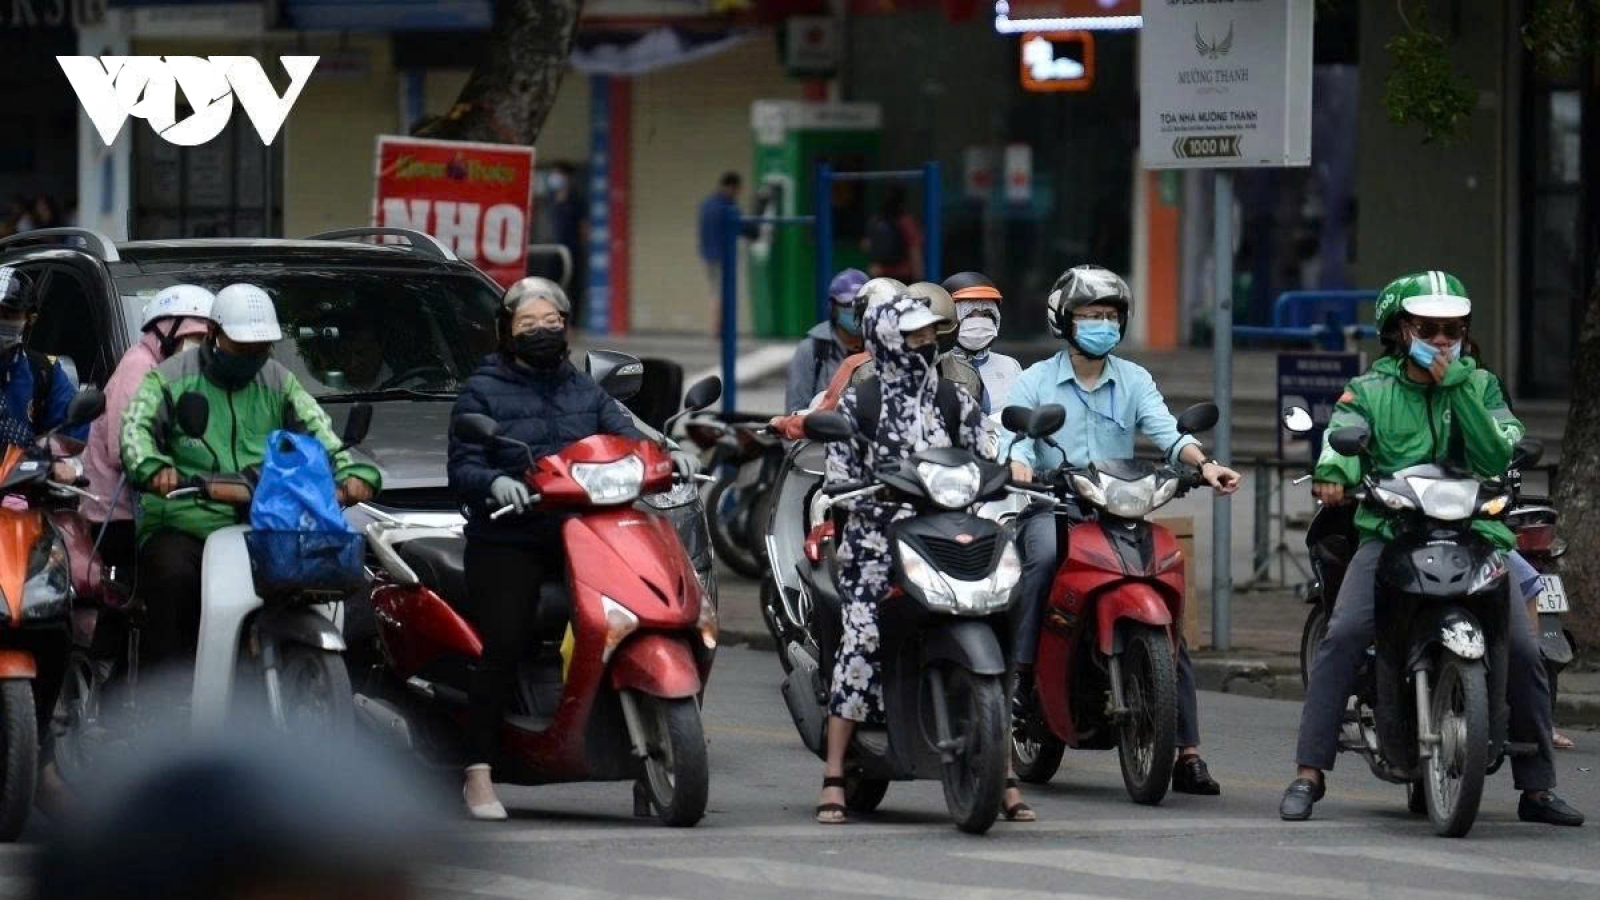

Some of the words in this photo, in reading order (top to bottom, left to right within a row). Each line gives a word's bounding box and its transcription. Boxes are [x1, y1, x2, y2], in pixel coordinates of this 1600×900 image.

[1215, 68, 1248, 83] THANH
[1190, 139, 1217, 154] 1000
[1219, 139, 1229, 154] M
[384, 198, 524, 264] NHO
